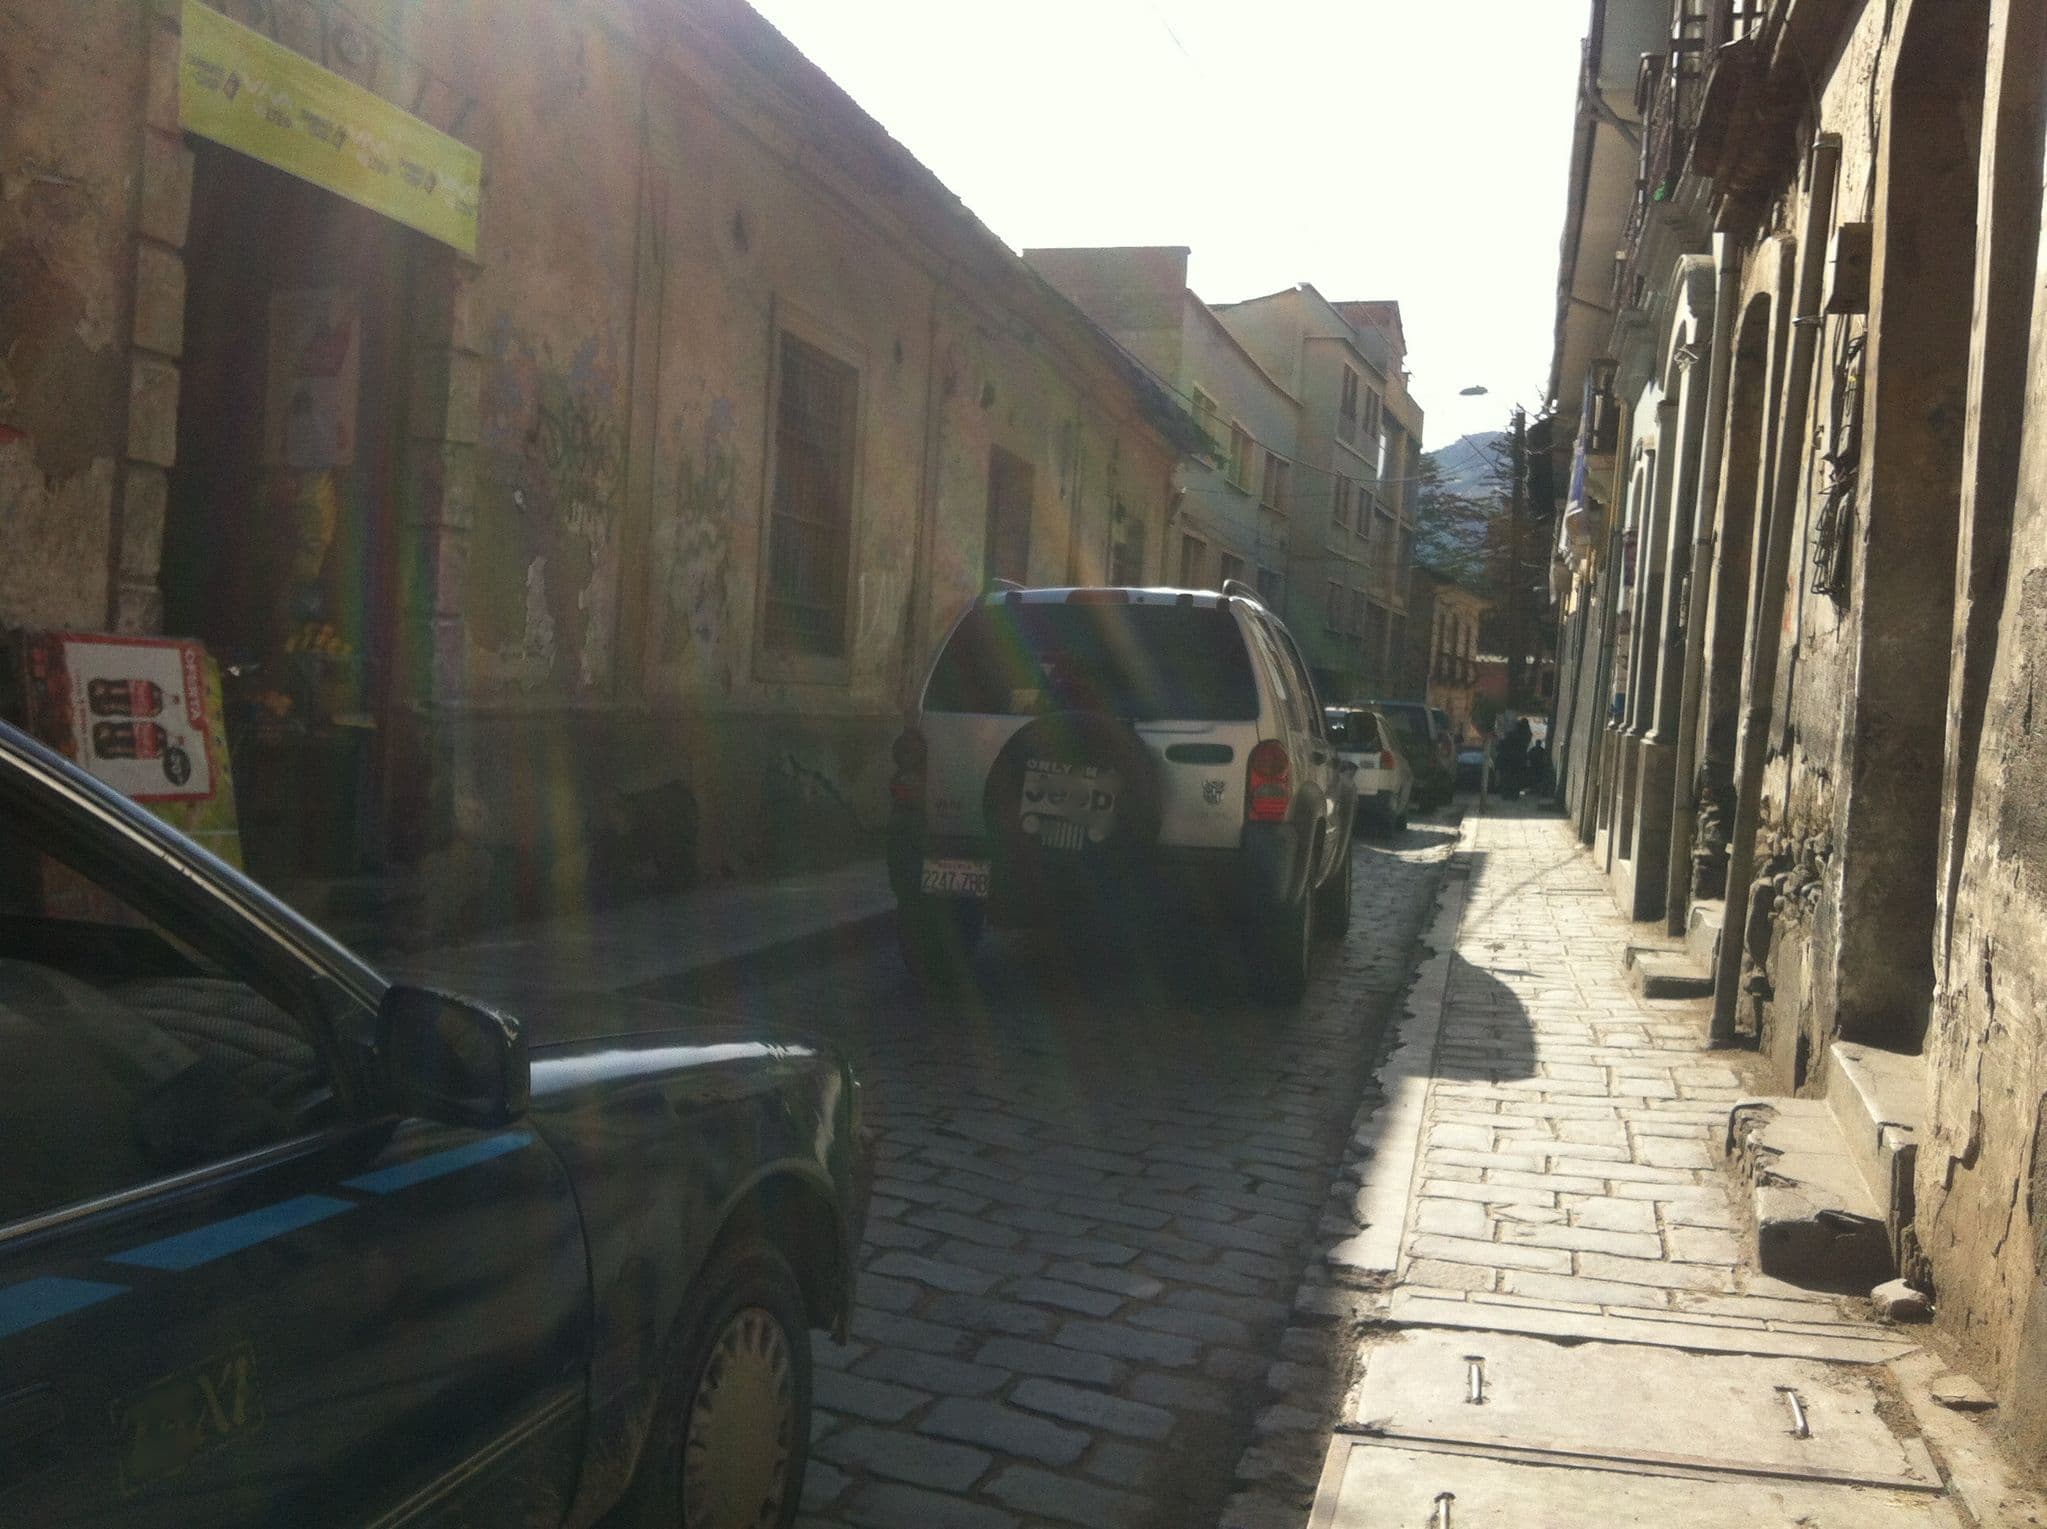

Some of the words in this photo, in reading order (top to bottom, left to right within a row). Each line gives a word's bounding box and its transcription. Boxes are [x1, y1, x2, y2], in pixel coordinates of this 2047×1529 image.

[184, 648, 203, 721] OFERTA
[1025, 758, 1073, 775] ONLY
[1025, 778, 1114, 811] Jep
[121, 1355, 249, 1477] TXI
